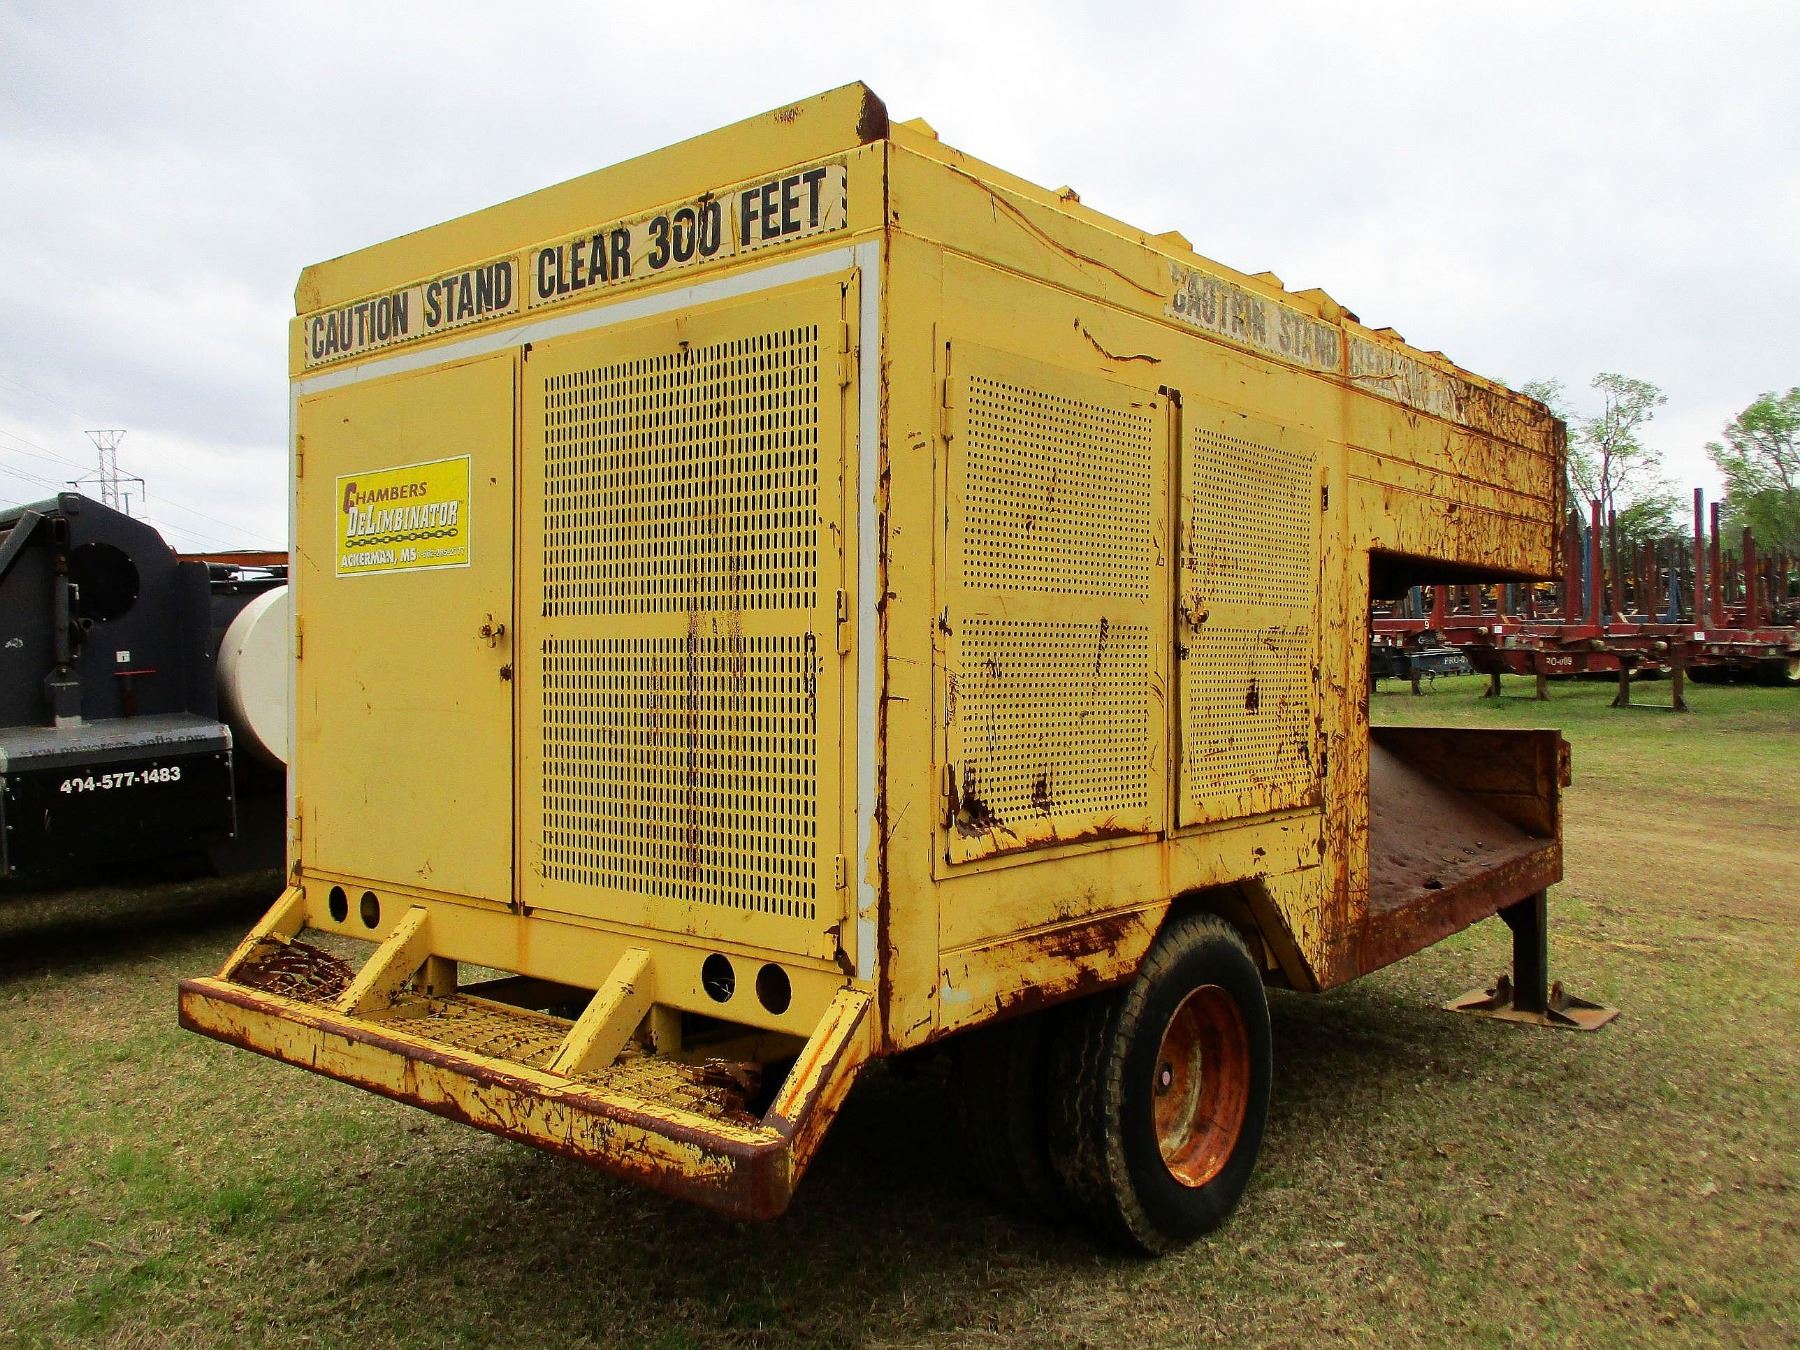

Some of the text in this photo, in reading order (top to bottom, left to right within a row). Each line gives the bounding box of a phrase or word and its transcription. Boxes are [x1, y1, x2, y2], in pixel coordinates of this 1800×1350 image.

[310, 167, 827, 359] CAUTION STAND CLEAR 300 FEET
[343, 482, 427, 514] CHAMBERS
[341, 549, 397, 568] ACKERMAN,
[401, 548, 417, 562] MS
